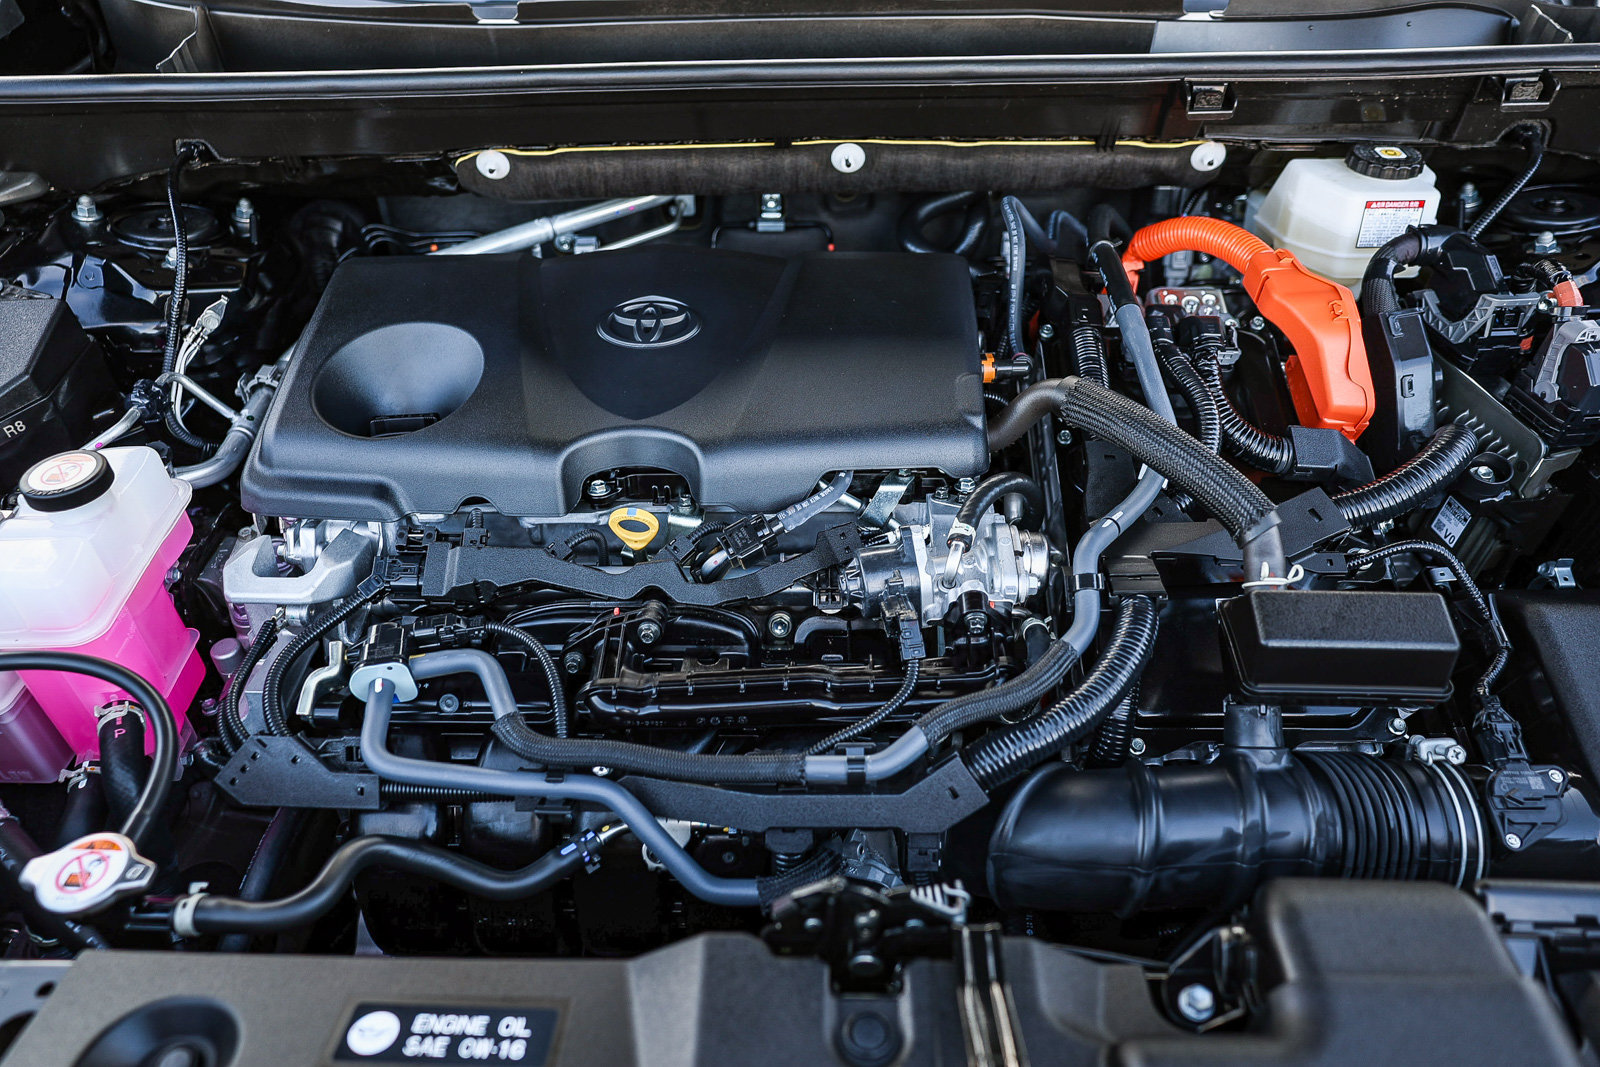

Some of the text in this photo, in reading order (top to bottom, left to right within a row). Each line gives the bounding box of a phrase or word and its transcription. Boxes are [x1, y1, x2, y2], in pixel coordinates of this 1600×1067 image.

[3, 420, 26, 438] R8
[410, 1013, 491, 1036] ENGINE
[402, 1035, 450, 1058] SAE
